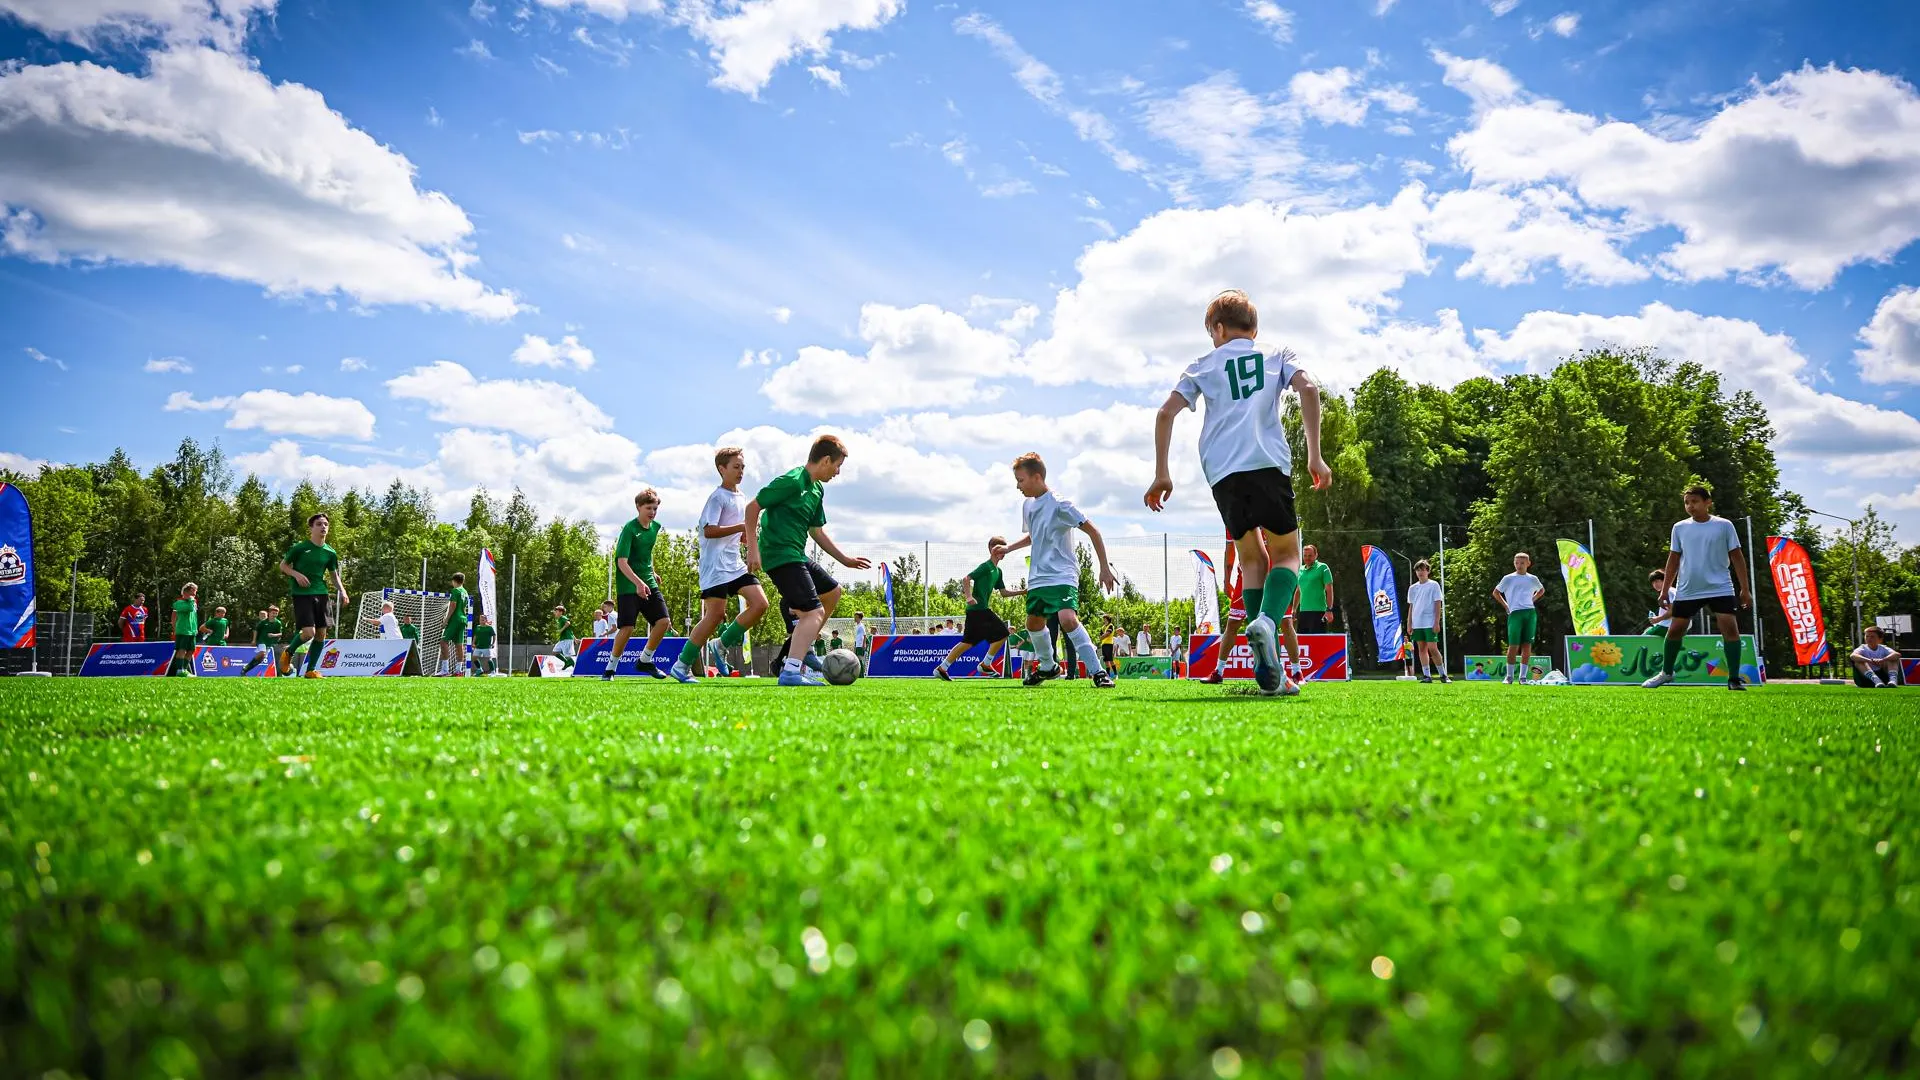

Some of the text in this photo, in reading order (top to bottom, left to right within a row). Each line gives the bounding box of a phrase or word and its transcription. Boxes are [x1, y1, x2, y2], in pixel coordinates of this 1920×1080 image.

[1224, 353, 1264, 400] 19
[892, 655, 980, 663] #КОМАНДАГУБАТОРА
[1620, 646, 1709, 678] Лео
